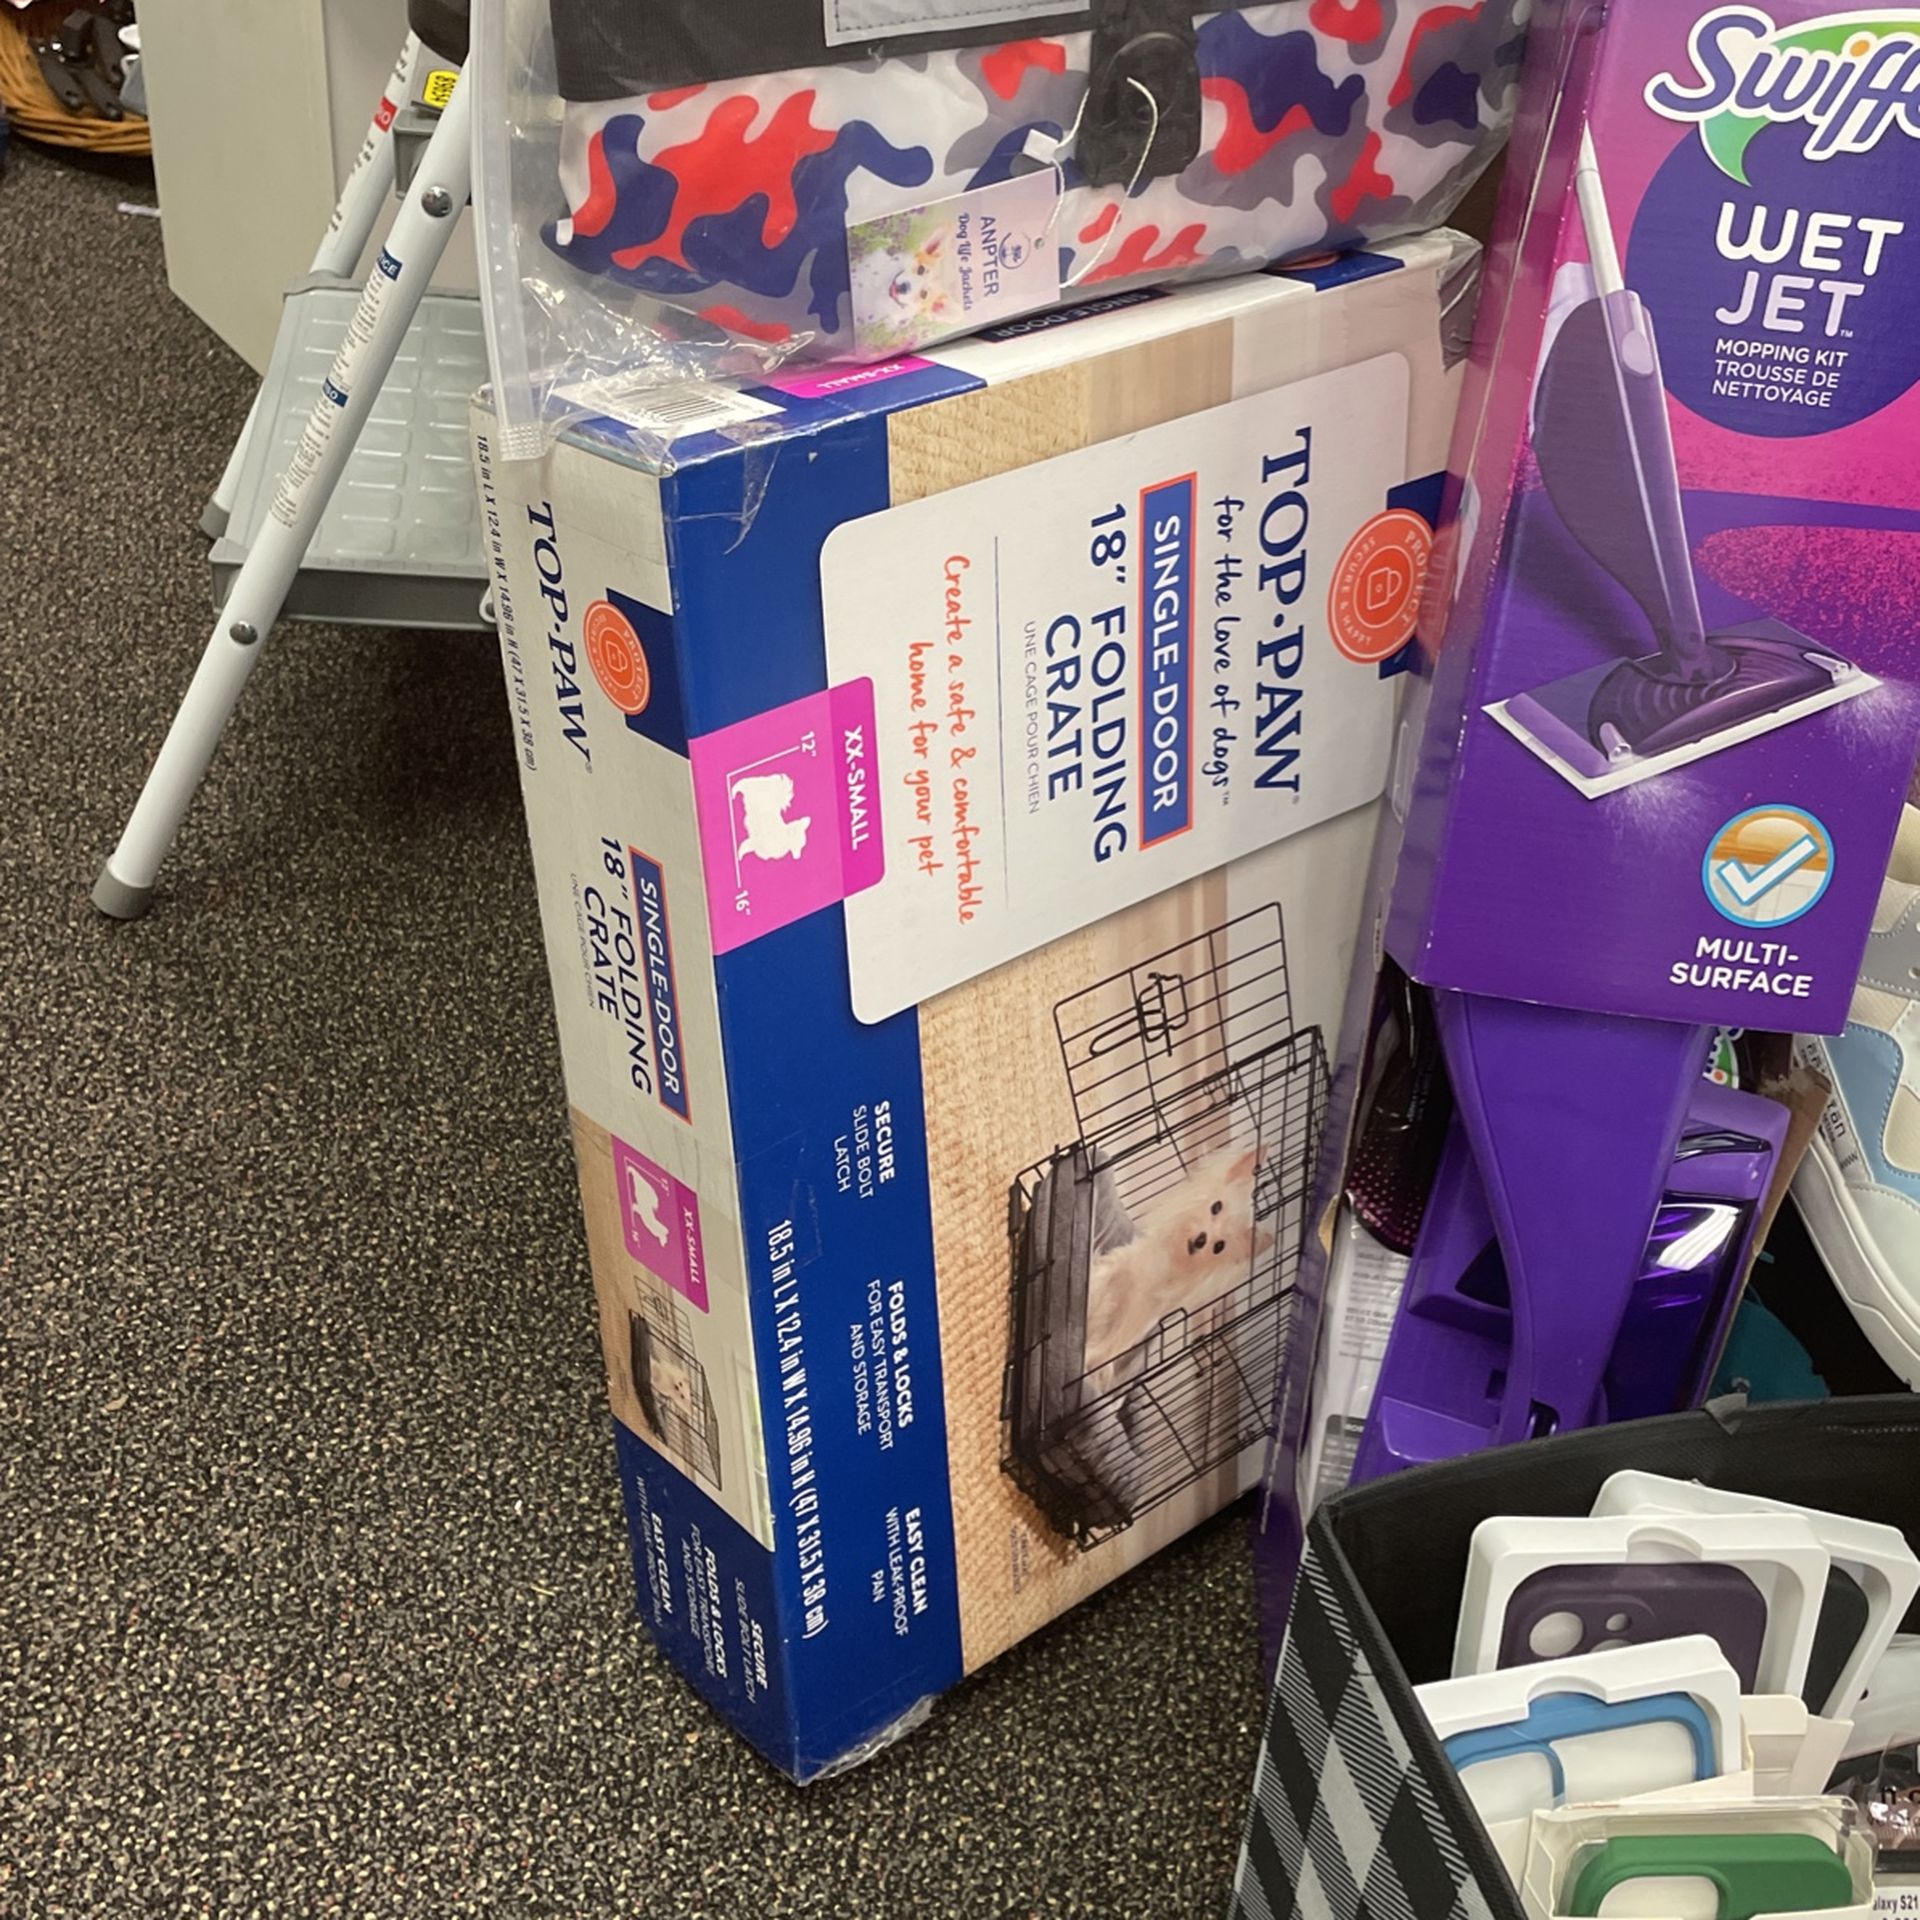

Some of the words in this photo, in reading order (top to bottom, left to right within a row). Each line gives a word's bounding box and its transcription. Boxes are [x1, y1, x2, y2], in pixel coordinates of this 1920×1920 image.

[956, 212, 970, 239] Dog
[1715, 202, 1904, 277] WET
[980, 215, 1000, 297] ANPTER
[1714, 338, 1810, 365] MOPPING
[1813, 345, 1849, 369] KIT
[1714, 359, 1807, 386] TROUSSE
[1811, 369, 1840, 389] DE
[1712, 381, 1832, 408] NETTOYAGE
[477, 434, 491, 464] 18.5
[485, 494, 497, 506] X
[496, 571, 508, 582] X
[1213, 495, 1245, 543] for
[944, 554, 971, 646] Create
[1214, 554, 1243, 608] the
[948, 653, 964, 674] a
[1023, 620, 1037, 659] UNE
[1152, 515, 1180, 812] SINGLE-DOOR
[1212, 614, 1242, 675] love
[909, 641, 934, 712] home
[1025, 661, 1039, 710] CAGE
[948, 680, 976, 739] safe
[1045, 614, 1083, 801] CRATE
[1210, 684, 1241, 719] of
[908, 723, 938, 760] for
[1026, 711, 1040, 763] POUR
[1090, 605, 1128, 863] FOLDING
[950, 747, 977, 770] &
[844, 725, 869, 850] XX-SMALL
[904, 767, 933, 827] your
[1027, 761, 1040, 816] CHIEN
[908, 838, 943, 878] pet
[951, 778, 984, 926] comfortable
[584, 885, 620, 1021] CRATE
[1695, 936, 1799, 967] MULTI-
[611, 905, 651, 1095] FOLDING
[640, 877, 680, 1094] SINGLE-DOOR
[1669, 962, 1813, 998] SURFACE
[853, 1105, 869, 1156] SLIDE
[874, 1100, 895, 1184] SECURE
[834, 1135, 851, 1193] LATCH
[856, 1155, 874, 1200] BOLT
[683, 1206, 701, 1284] XX-SMALL
[771, 1259, 796, 1282] in
[773, 1279, 798, 1299] L
[775, 1293, 800, 1315] X
[867, 1279, 882, 1317] FOR
[888, 1280, 907, 1346] FOLDS
[850, 1323, 865, 1359] AND
[869, 1314, 887, 1358] EASY
[892, 1345, 909, 1364] &
[780, 1349, 804, 1373] in
[781, 1370, 807, 1392] W
[783, 1387, 809, 1408] X
[853, 1360, 872, 1436] STORAGE
[872, 1357, 894, 1452] TRANSPORT
[894, 1364, 914, 1429] LOCKS
[790, 1450, 814, 1475] in
[792, 1469, 815, 1490] H
[788, 1487, 818, 1517] (47
[796, 1514, 820, 1535] X
[651, 1511, 667, 1559] EASY
[885, 1506, 902, 1548] WITH
[904, 1507, 923, 1554] EASY
[657, 1558, 673, 1615] CLEAN
[704, 1545, 720, 1604] FOLDS
[801, 1563, 825, 1585] X
[802, 1578, 827, 1606] 38
[871, 1568, 886, 1604] PAN
[889, 1548, 909, 1637] LEAK-PROOF
[909, 1556, 928, 1616] CLEAN
[734, 1577, 748, 1620] SLIDE
[743, 1655, 756, 1705] LATCH
[802, 1605, 829, 1639] cm)
[711, 1620, 728, 1679] LOCKS
[751, 1618, 768, 1690] SECURE
